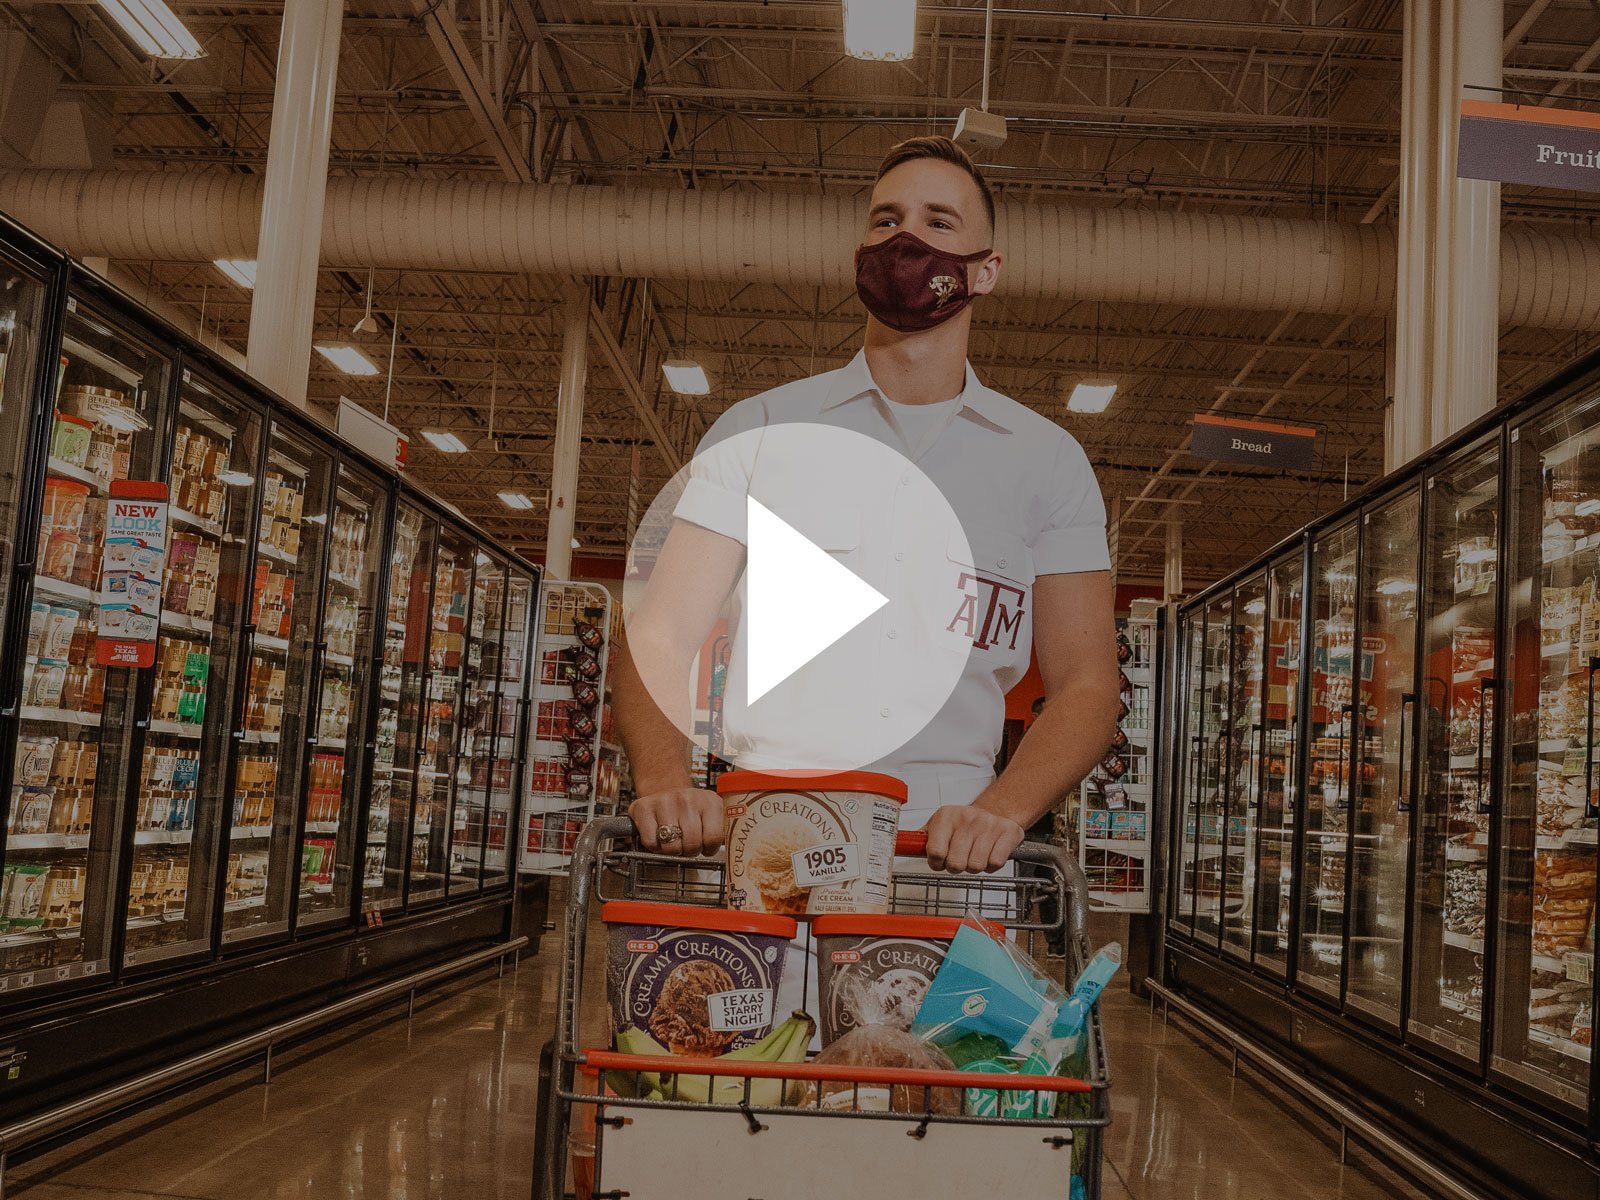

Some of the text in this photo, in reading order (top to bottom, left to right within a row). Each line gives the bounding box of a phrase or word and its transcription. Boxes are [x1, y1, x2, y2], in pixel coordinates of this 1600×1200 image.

[1231, 438, 1272, 454] Bread
[115, 504, 159, 518] NEW
[111, 517, 161, 531] LOOK
[733, 813, 758, 877] CREAMY
[760, 801, 835, 841] CREATIONS
[804, 847, 846, 869] 1905
[809, 866, 846, 877] VANILLA
[633, 939, 755, 1017] CREAMY CREATIONS
[721, 993, 764, 1006] TEXAS
[724, 1004, 763, 1016] STARRY
[725, 1013, 764, 1027] NIGHT
